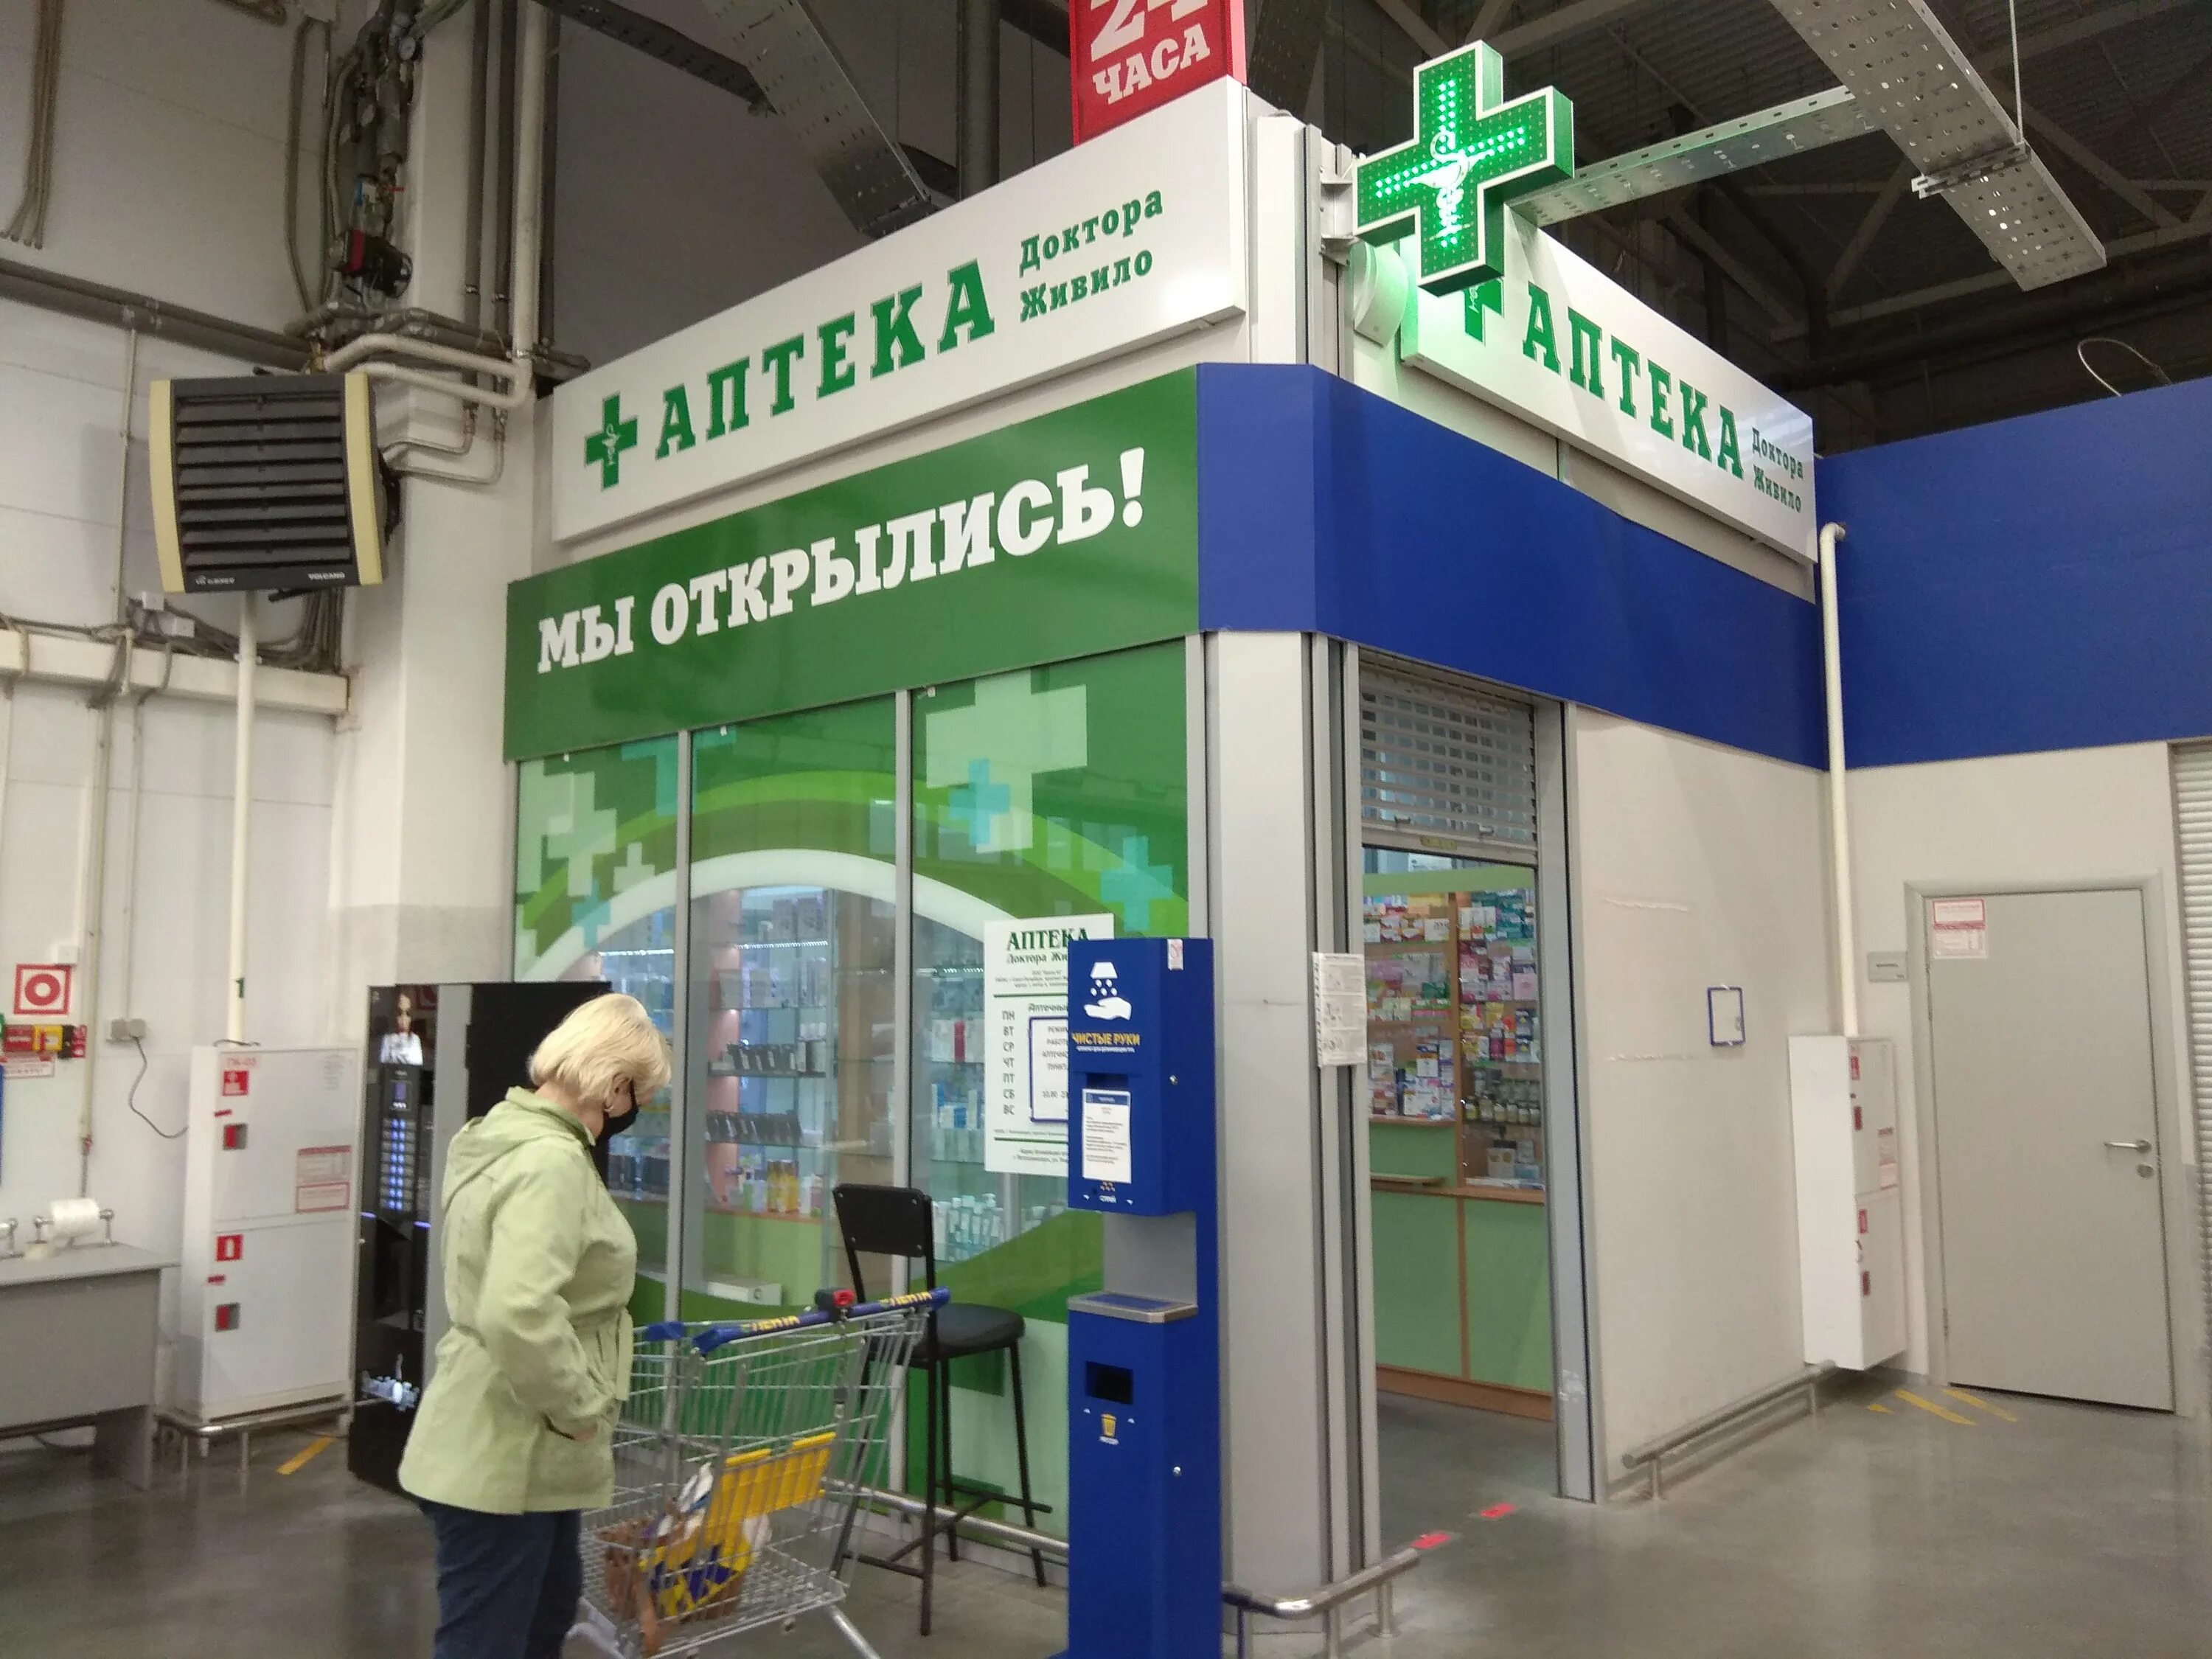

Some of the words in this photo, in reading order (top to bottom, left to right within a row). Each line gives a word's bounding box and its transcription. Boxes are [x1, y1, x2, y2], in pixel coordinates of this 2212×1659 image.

[1093, 23, 1210, 105] ЧАСА
[1019, 189, 1164, 276] Доктора
[1019, 249, 1152, 323] Живило
[655, 258, 995, 460] АПТЕКА
[1523, 281, 1744, 480] АПТЕКА
[1751, 427, 1804, 479] Доктора
[1753, 465, 1801, 512] Живило
[538, 596, 634, 674] МЫ
[650, 447, 1145, 645] ОТКРЫЛИСЬ!
[1007, 953, 1047, 965] Доктора
[1002, 1011, 1015, 1020] ПН
[1004, 1026, 1015, 1036] ВТ
[1071, 1032, 1113, 1045] ЧИСТЫЕ
[1113, 1033, 1140, 1046] РУКИ
[1003, 1042, 1015, 1052] СР
[1004, 1058, 1015, 1068] ЧТ
[1003, 1074, 1015, 1083] ПТ
[1003, 1089, 1015, 1099] СБ
[1003, 1105, 1015, 1115] ВС
